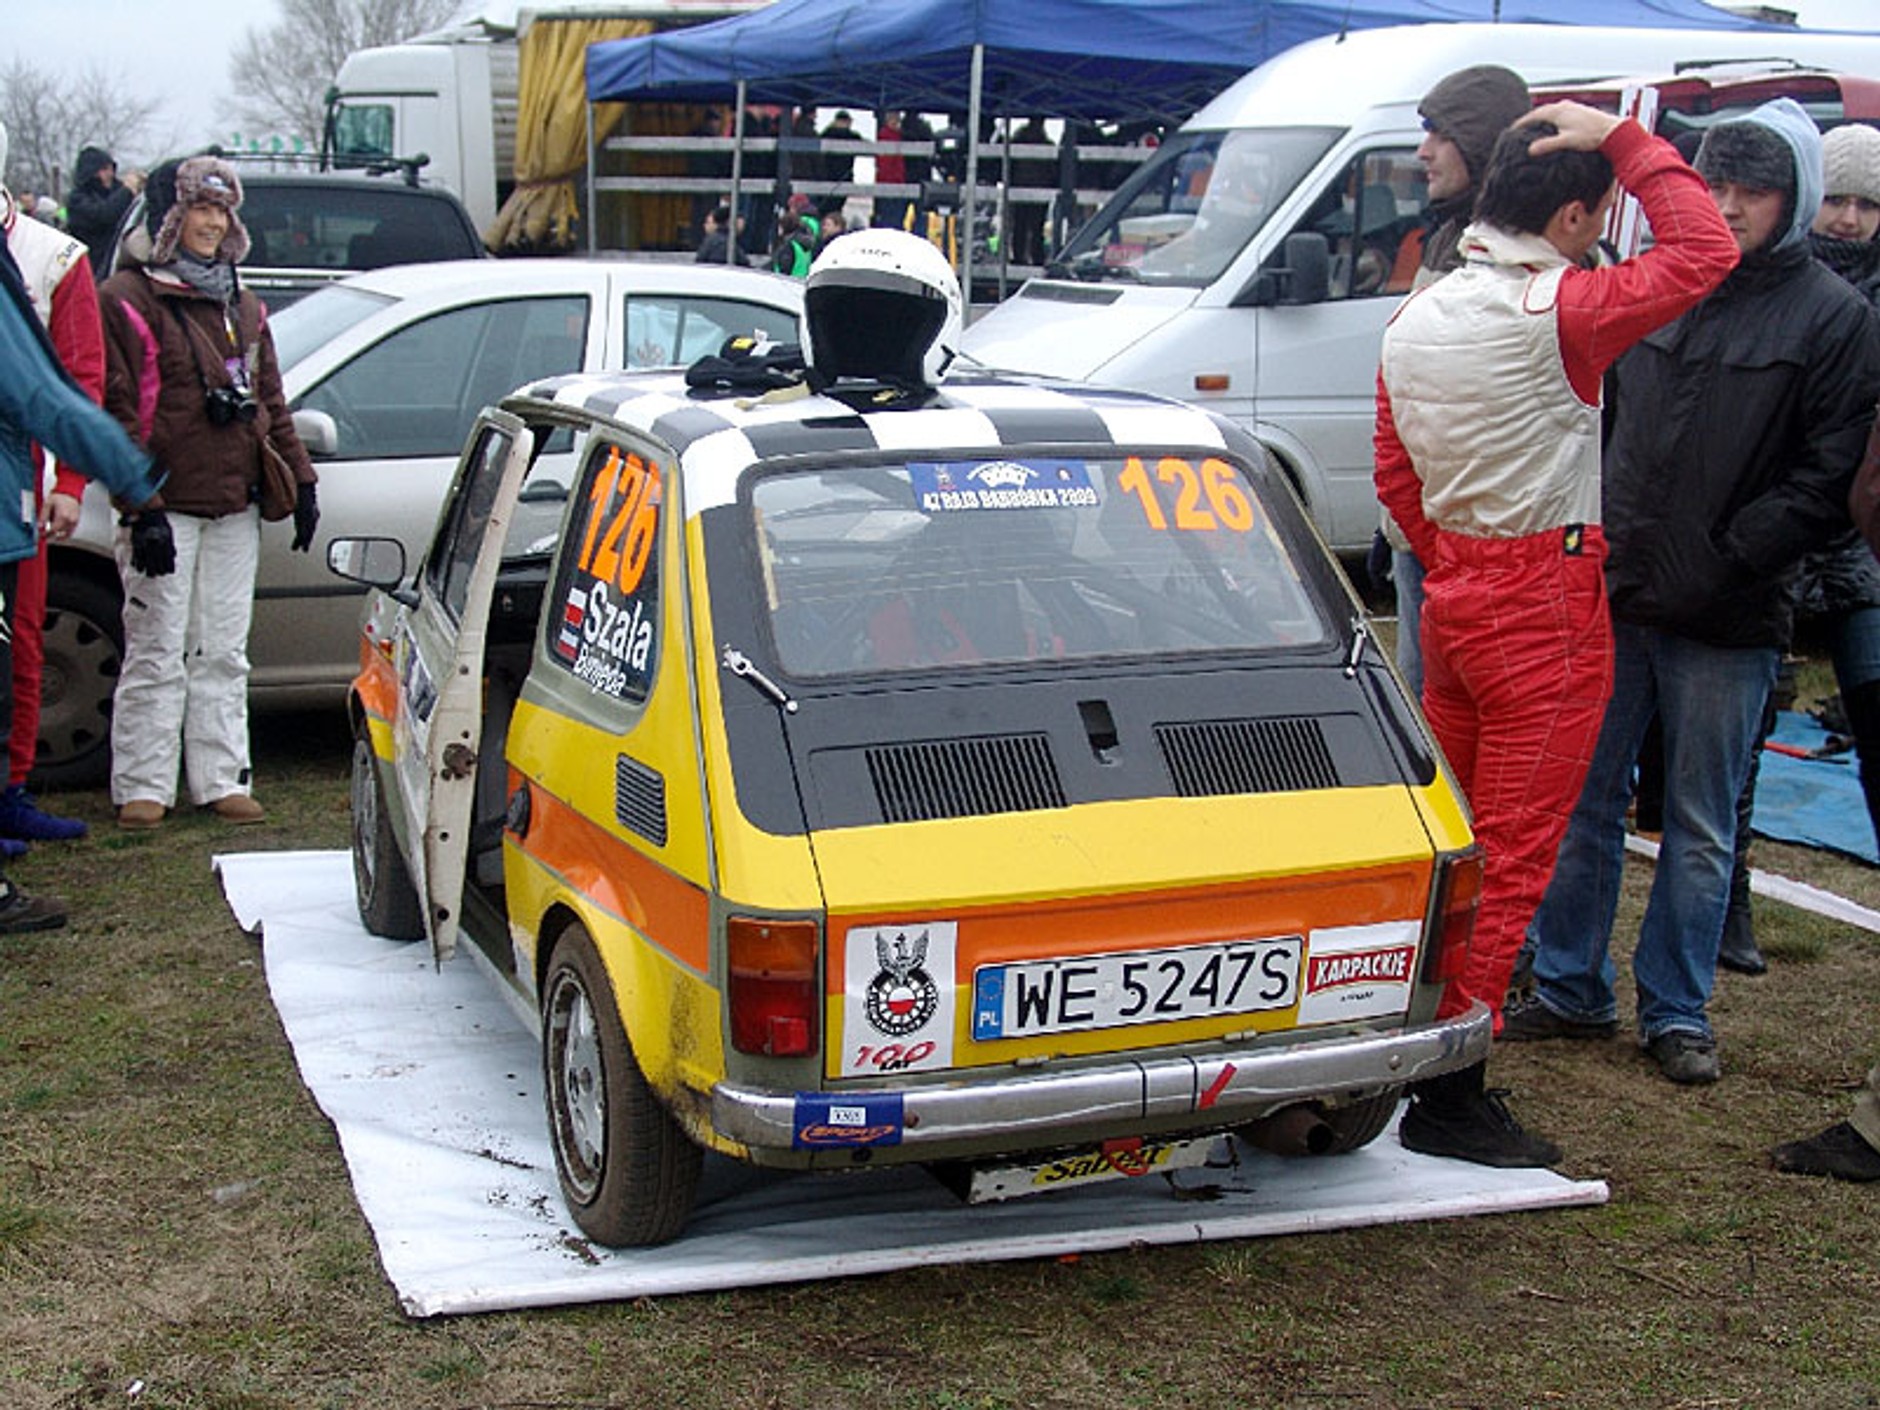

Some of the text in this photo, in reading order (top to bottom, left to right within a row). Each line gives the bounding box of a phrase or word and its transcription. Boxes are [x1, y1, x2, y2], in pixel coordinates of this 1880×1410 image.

[577, 444, 662, 594] 126
[1118, 455, 1254, 532] 126
[1016, 948, 1292, 1028] WE 5247S
[1314, 951, 1408, 987] KARPACKIE
[979, 1011, 999, 1027] PL
[853, 1041, 937, 1067] 100
